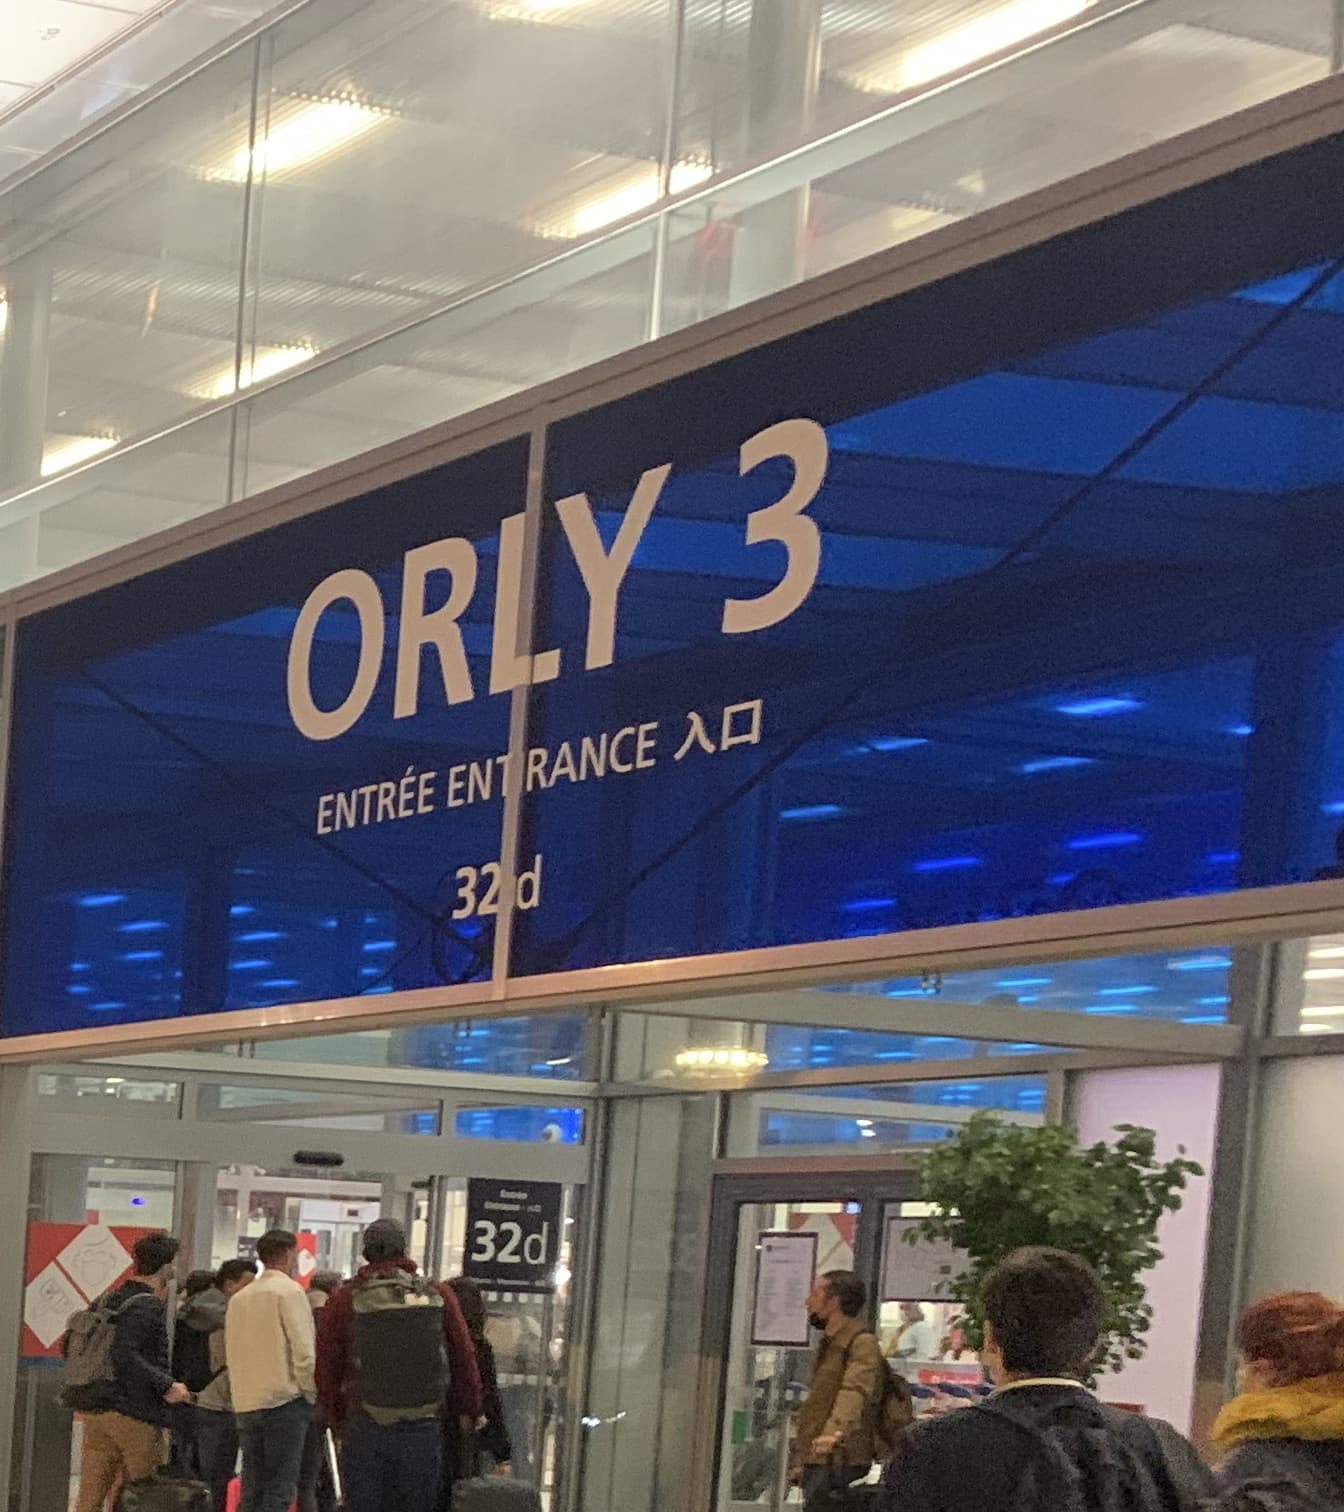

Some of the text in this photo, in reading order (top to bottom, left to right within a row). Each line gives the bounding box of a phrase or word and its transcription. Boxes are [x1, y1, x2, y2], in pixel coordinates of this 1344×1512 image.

[285, 417, 829, 741] ORLY 3
[315, 765, 438, 836] ENTRÉE
[673, 698, 763, 761] 入口
[452, 853, 543, 919] 32d
[471, 1219, 550, 1265] 32d
